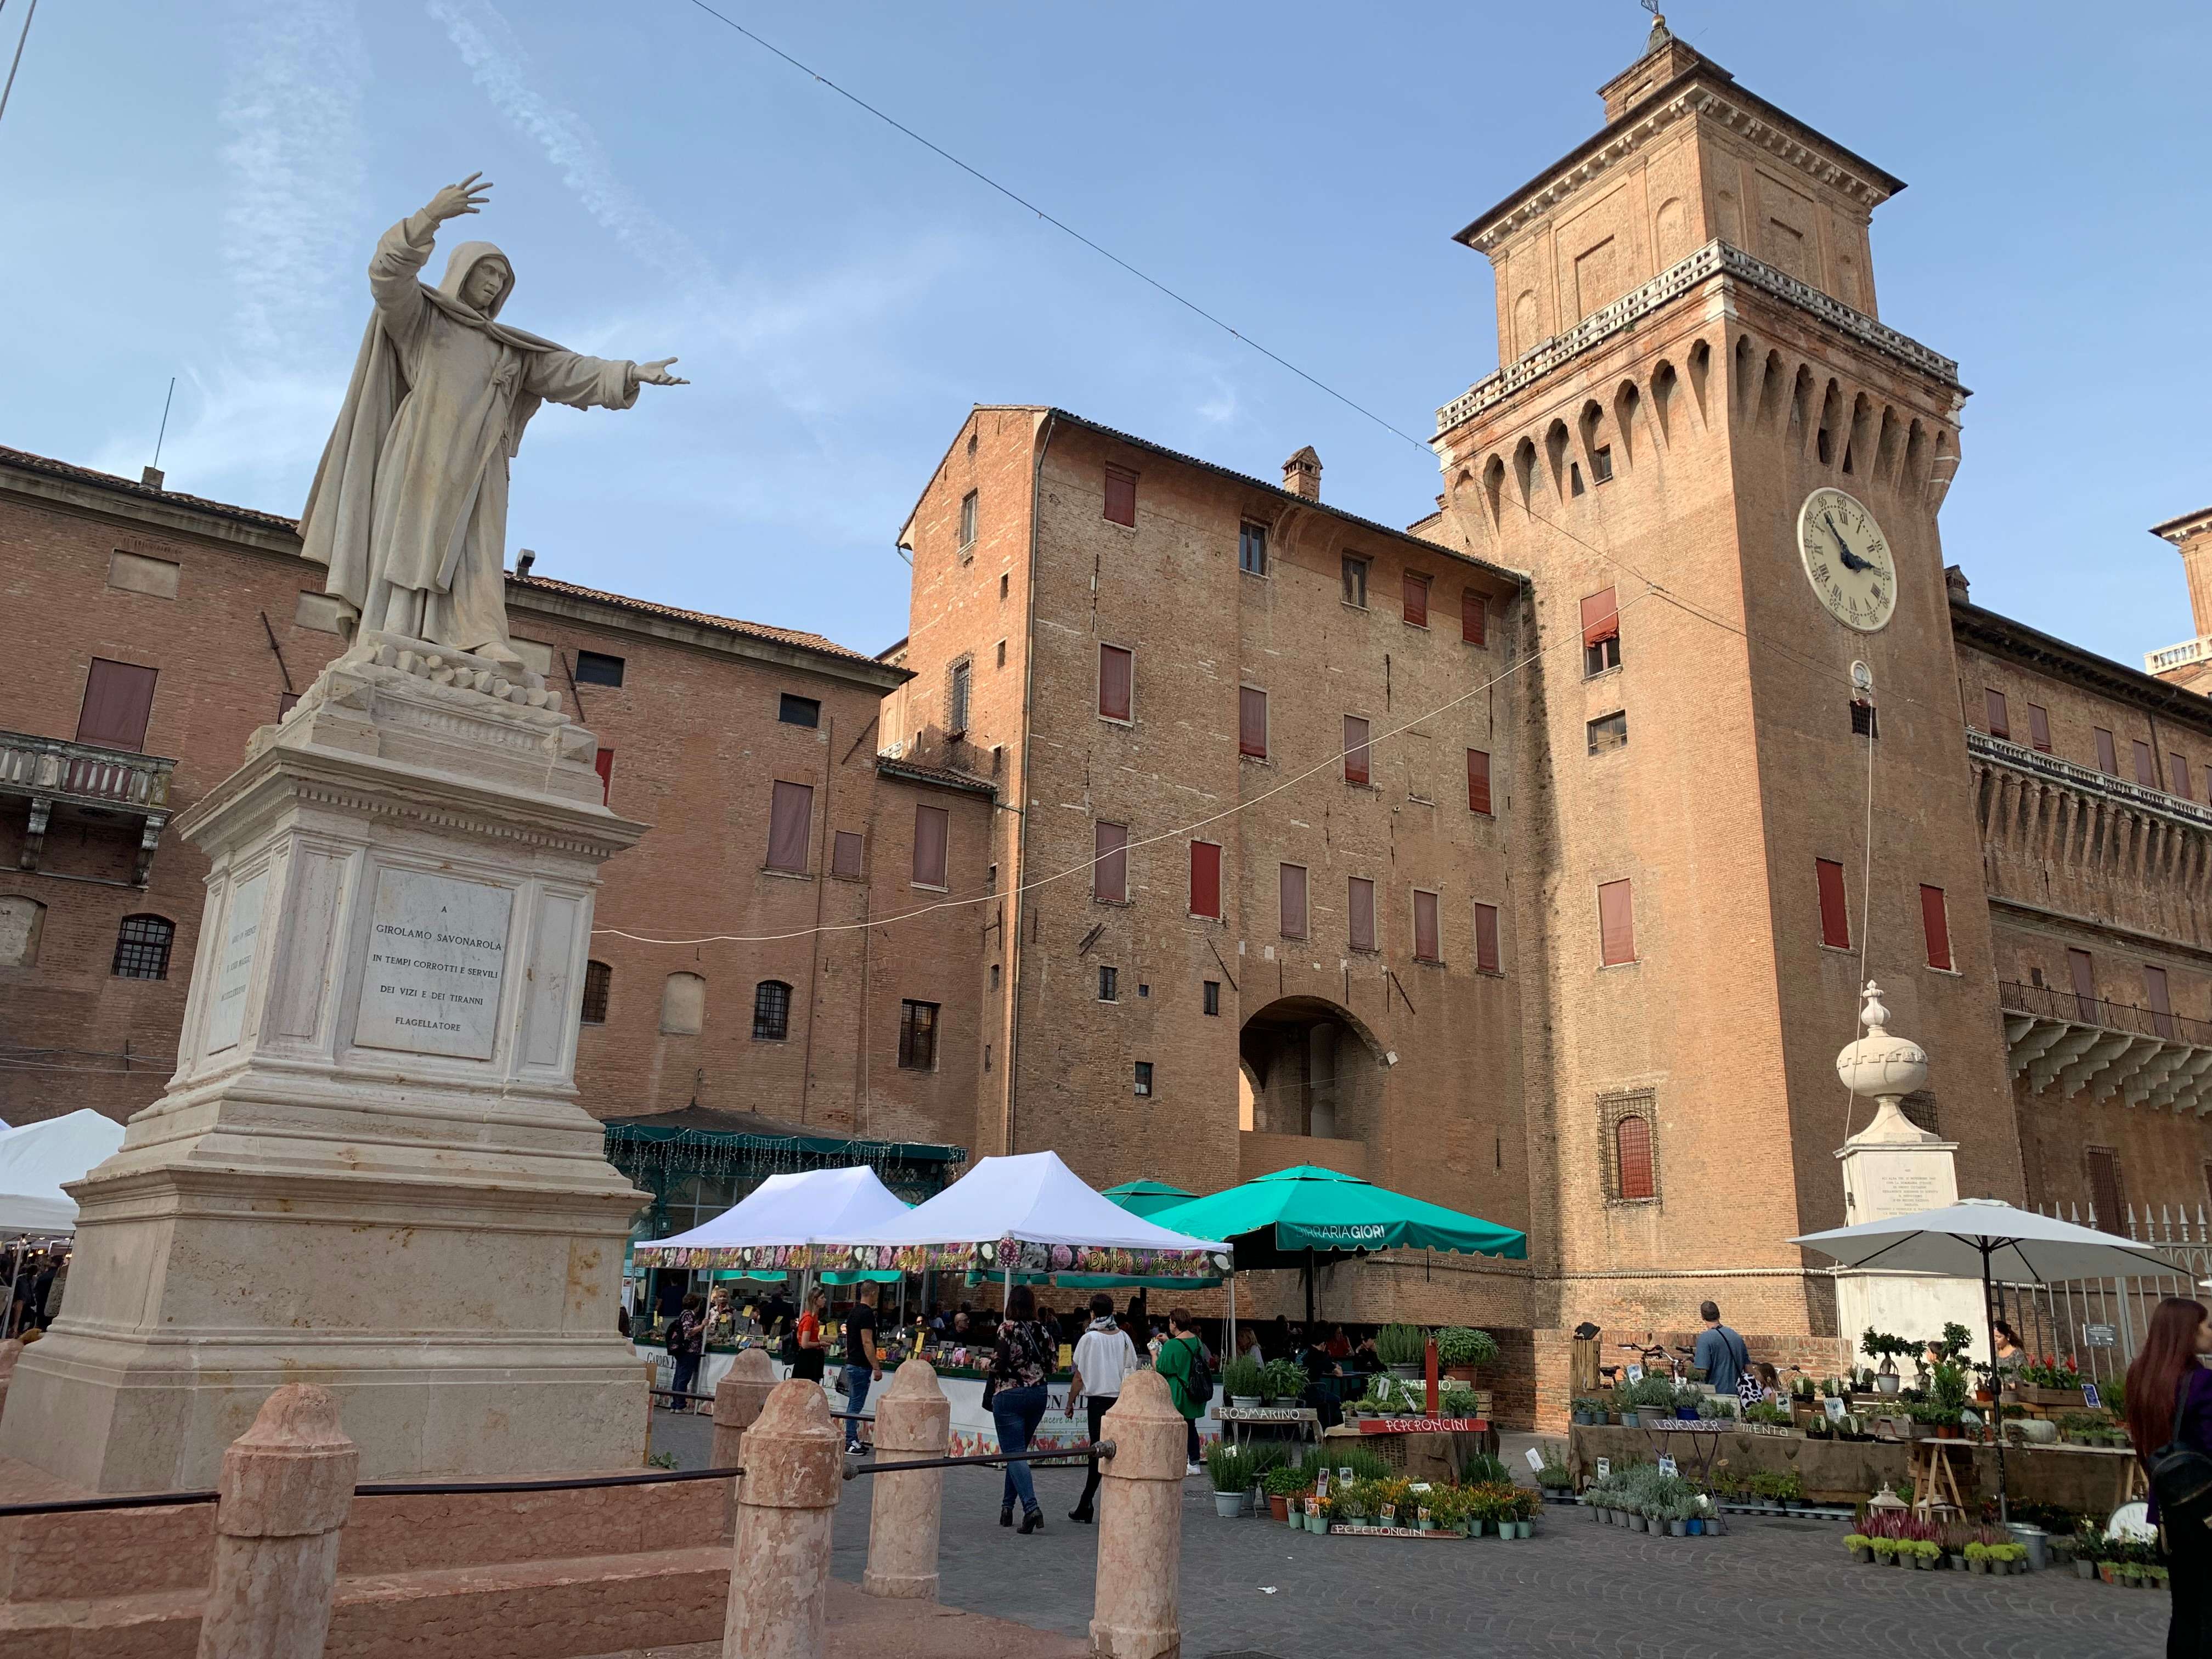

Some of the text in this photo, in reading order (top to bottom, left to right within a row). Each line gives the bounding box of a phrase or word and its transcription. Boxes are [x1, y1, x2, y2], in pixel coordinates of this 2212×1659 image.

[1818, 496, 1827, 507] 55
[1837, 496, 1847, 507] 60
[1805, 511, 1814, 524] 50
[1838, 510, 1849, 526] XII
[1859, 514, 1865, 522] 5
[1866, 544, 1876, 554] II
[1876, 540, 1883, 551] 10
[1864, 597, 1872, 611] V
[376, 924, 502, 951] GIROLAMO SAVONAROLA
[373, 954, 382, 962] IN
[385, 956, 411, 967] TEMPI
[414, 960, 458, 973] CORROTTI
[467, 968, 498, 979] SERVILI
[380, 985, 395, 994] DEI
[400, 988, 417, 997] VIZI
[431, 992, 445, 1001] DEI
[450, 994, 483, 1006] TIRANNI
[395, 1017, 461, 1032] FLAGELLATORE
[1351, 1224, 1385, 1239] GIORI
[1088, 1251, 1199, 1272] Bulbi e rizomi
[1218, 1407, 1300, 1420] ROSMARINO
[1384, 1418, 1469, 1432] PEPERONCINI
[1335, 1524, 1426, 1537] PEPERONCINI
